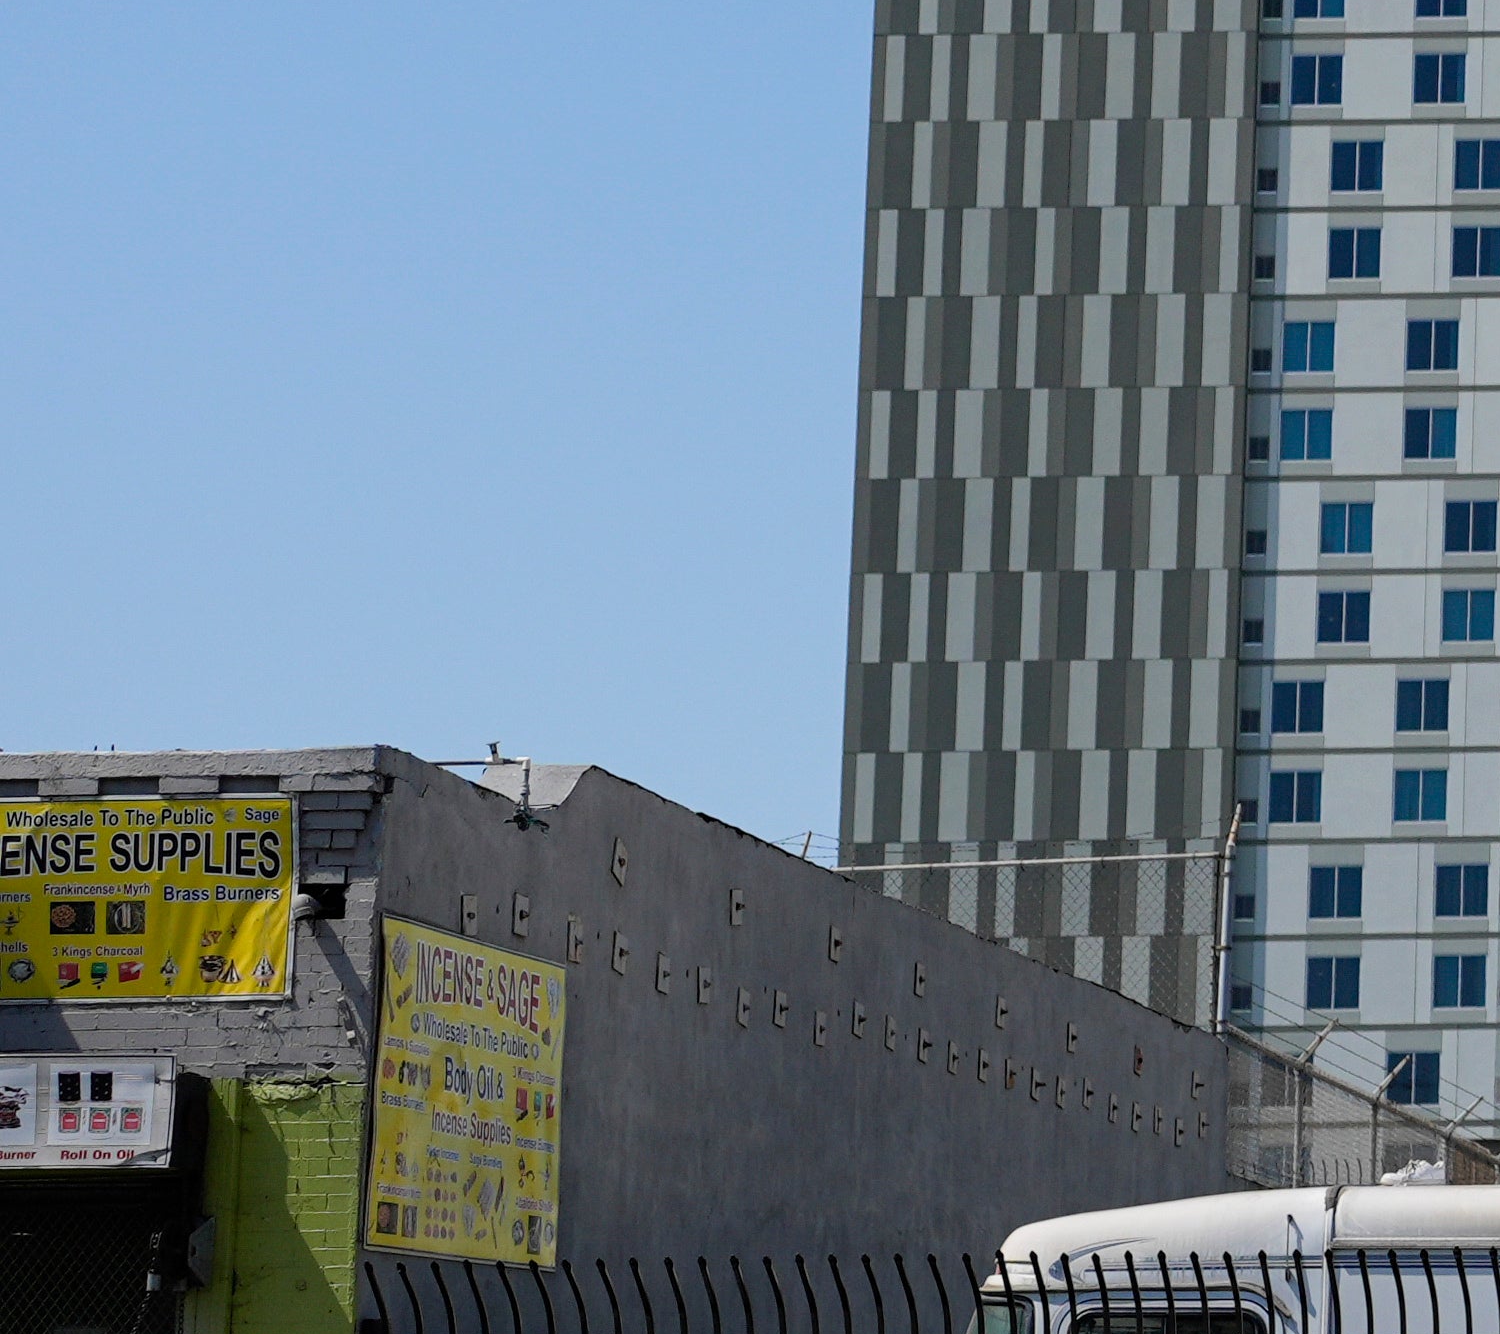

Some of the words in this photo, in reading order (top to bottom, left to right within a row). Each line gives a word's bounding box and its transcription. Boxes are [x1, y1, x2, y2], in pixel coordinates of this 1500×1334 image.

[6, 810, 94, 827] Wholesale
[99, 809, 119, 826] To
[125, 809, 156, 826] The
[161, 808, 214, 825] Public
[244, 807, 280, 823] Sage
[0, 833, 96, 877] ENSE
[109, 831, 281, 879] SUPPLIES
[43, 883, 115, 896] Frankincense
[164, 885, 210, 901] Brass
[215, 885, 280, 901] Burners
[52, 947, 58, 957] 3
[61, 947, 92, 959] Kings
[95, 945, 144, 957] Charcoal
[415, 941, 485, 1009] INCENSE
[487, 969, 495, 1002] &
[497, 964, 541, 1034] SAGE
[423, 1011, 469, 1045] Wholesale
[470, 1024, 480, 1048] To
[483, 1027, 499, 1053] The
[501, 1031, 529, 1059] Public
[444, 1056, 473, 1105] Body
[477, 1064, 494, 1101] Oil
[497, 1072, 504, 1100] &
[381, 1090, 401, 1107] Brass
[431, 1105, 468, 1137] Incense
[470, 1112, 512, 1148] Supplies
[60, 1150, 87, 1160] Roll
[92, 1150, 112, 1160] On
[116, 1149, 136, 1160] Oil
